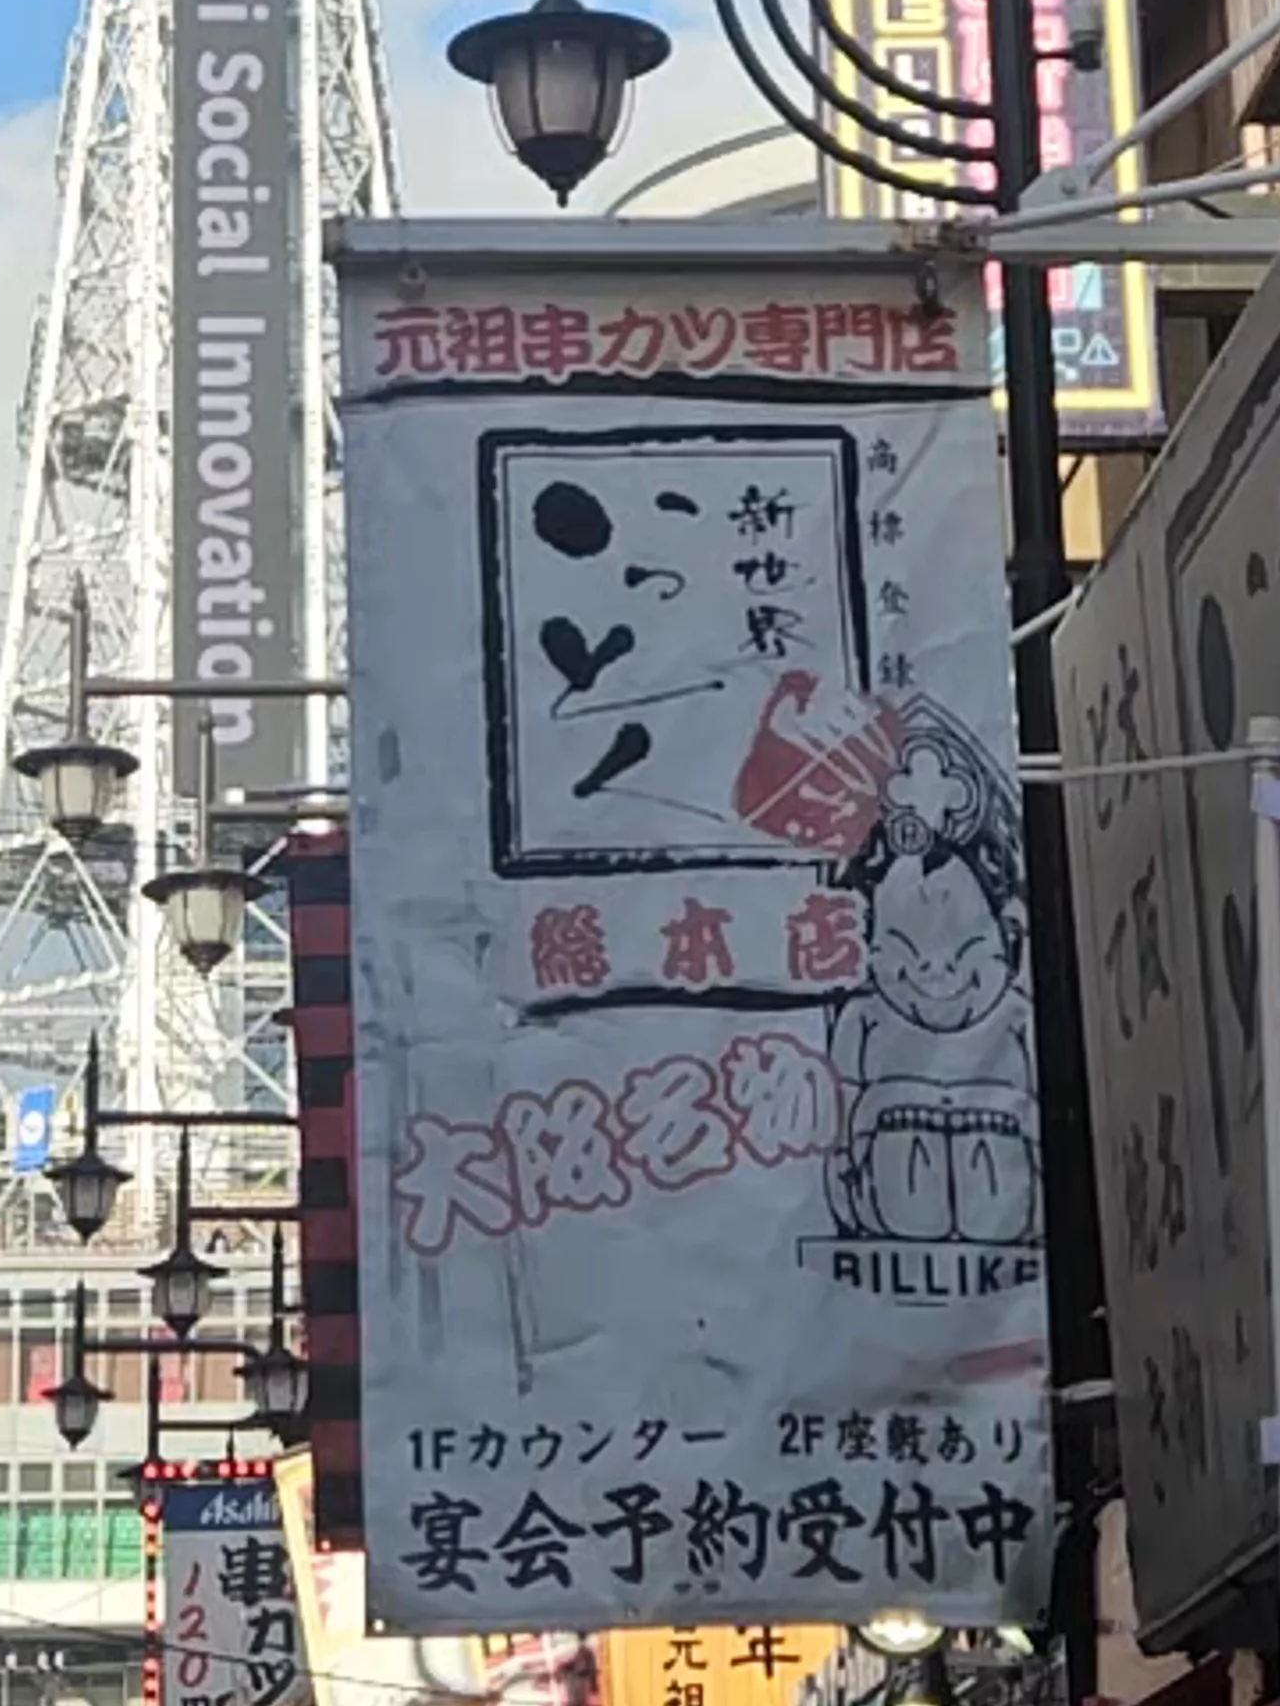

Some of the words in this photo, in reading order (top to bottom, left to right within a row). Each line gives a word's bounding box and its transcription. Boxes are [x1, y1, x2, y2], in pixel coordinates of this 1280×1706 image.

[194, 50, 271, 277] Social
[373, 302, 960, 384] 元祖串カツ専門店
[194, 316, 274, 743] Innovation
[728, 484, 816, 657] 新世界
[394, 1032, 846, 1255] 大阪名物
[408, 1425, 728, 1473] 1Fカウンター
[778, 1408, 1026, 1466] 2F座敷あり
[400, 1478, 1036, 1593] 宴会予約受付中
